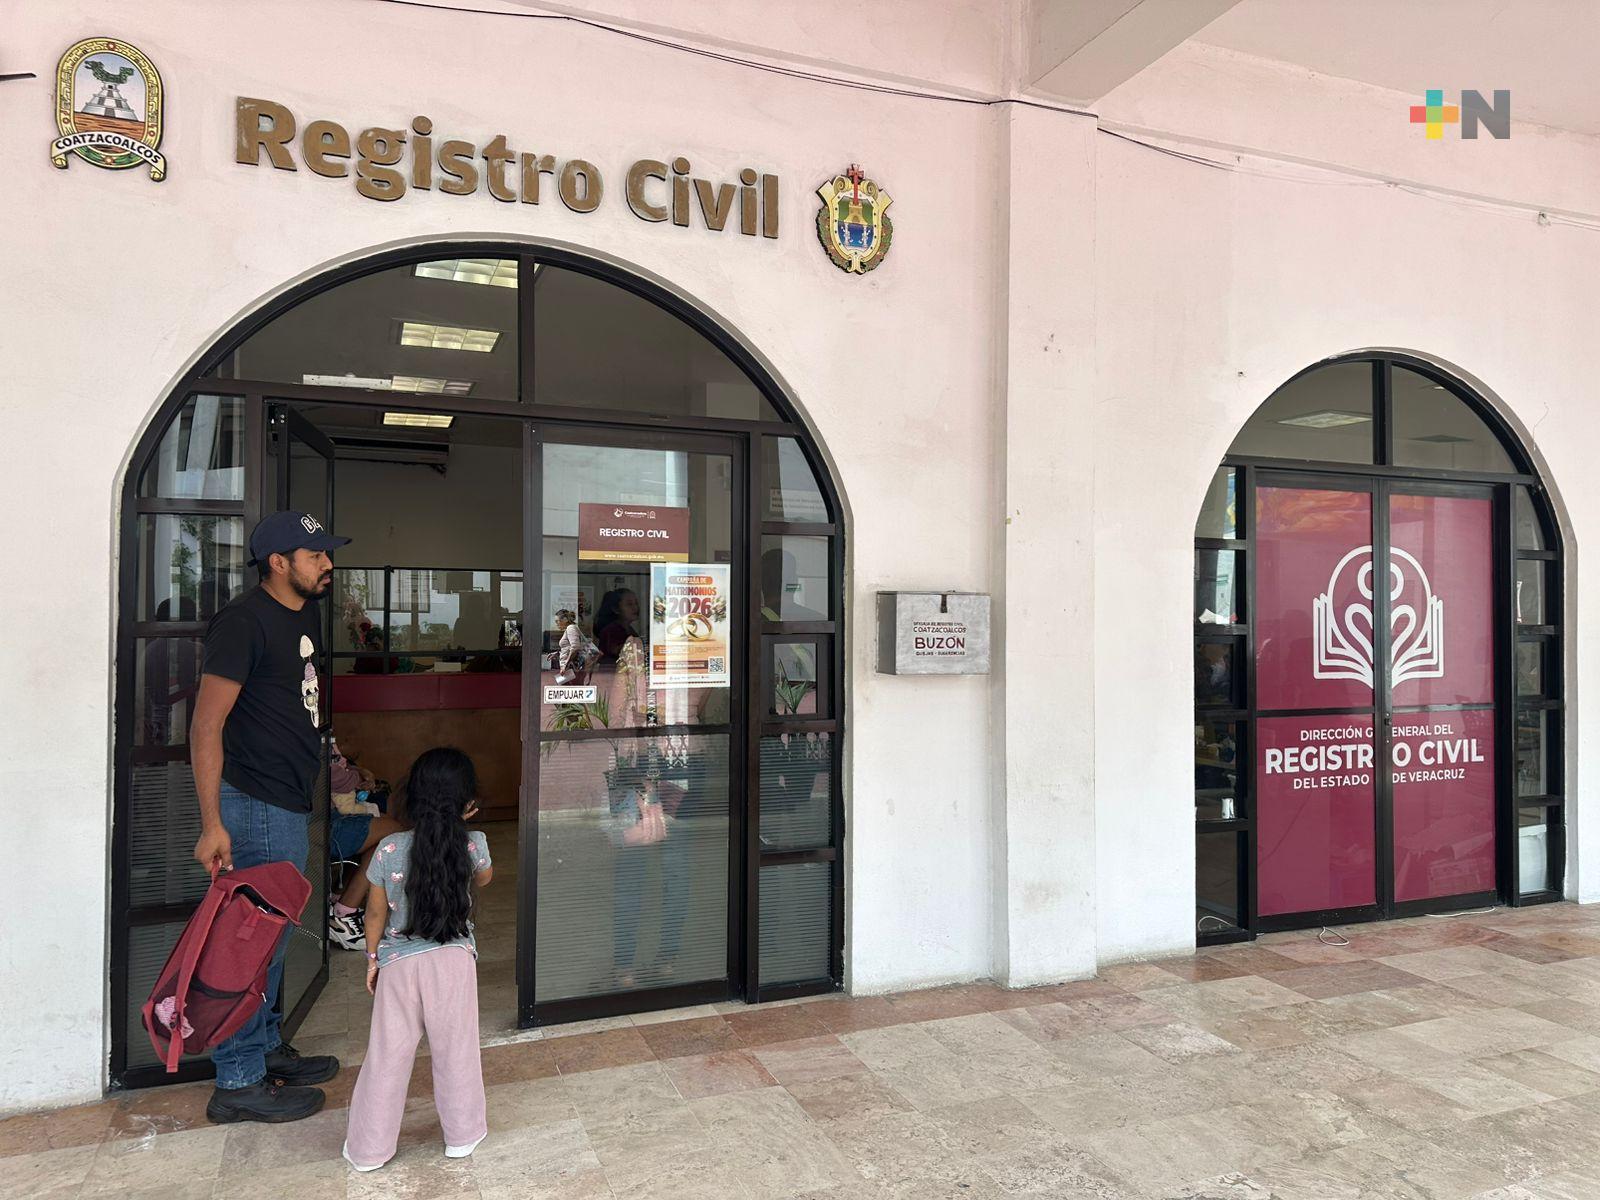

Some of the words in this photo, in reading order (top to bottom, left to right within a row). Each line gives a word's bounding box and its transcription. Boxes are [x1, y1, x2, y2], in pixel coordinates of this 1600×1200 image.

[55, 133, 161, 164] COATZACOALCOS
[236, 96, 604, 213] Registro
[626, 157, 779, 239] Civil
[599, 527, 645, 538] REGISTRO
[646, 529, 670, 539] CIVIL
[668, 597, 713, 618] 2026
[915, 635, 965, 649] BUZÓN
[548, 690, 584, 700] EMPUJAR
[1300, 725, 1363, 741] DIRECCIÓN
[1434, 724, 1455, 735] DEL
[1265, 742, 1412, 774] REGISTRO
[1418, 738, 1485, 766] CIVIL
[1293, 778, 1319, 790] DEL
[1320, 774, 1370, 788] ESTADO
[1392, 772, 1407, 784] DE
[1408, 768, 1466, 783] VERACRUZ
